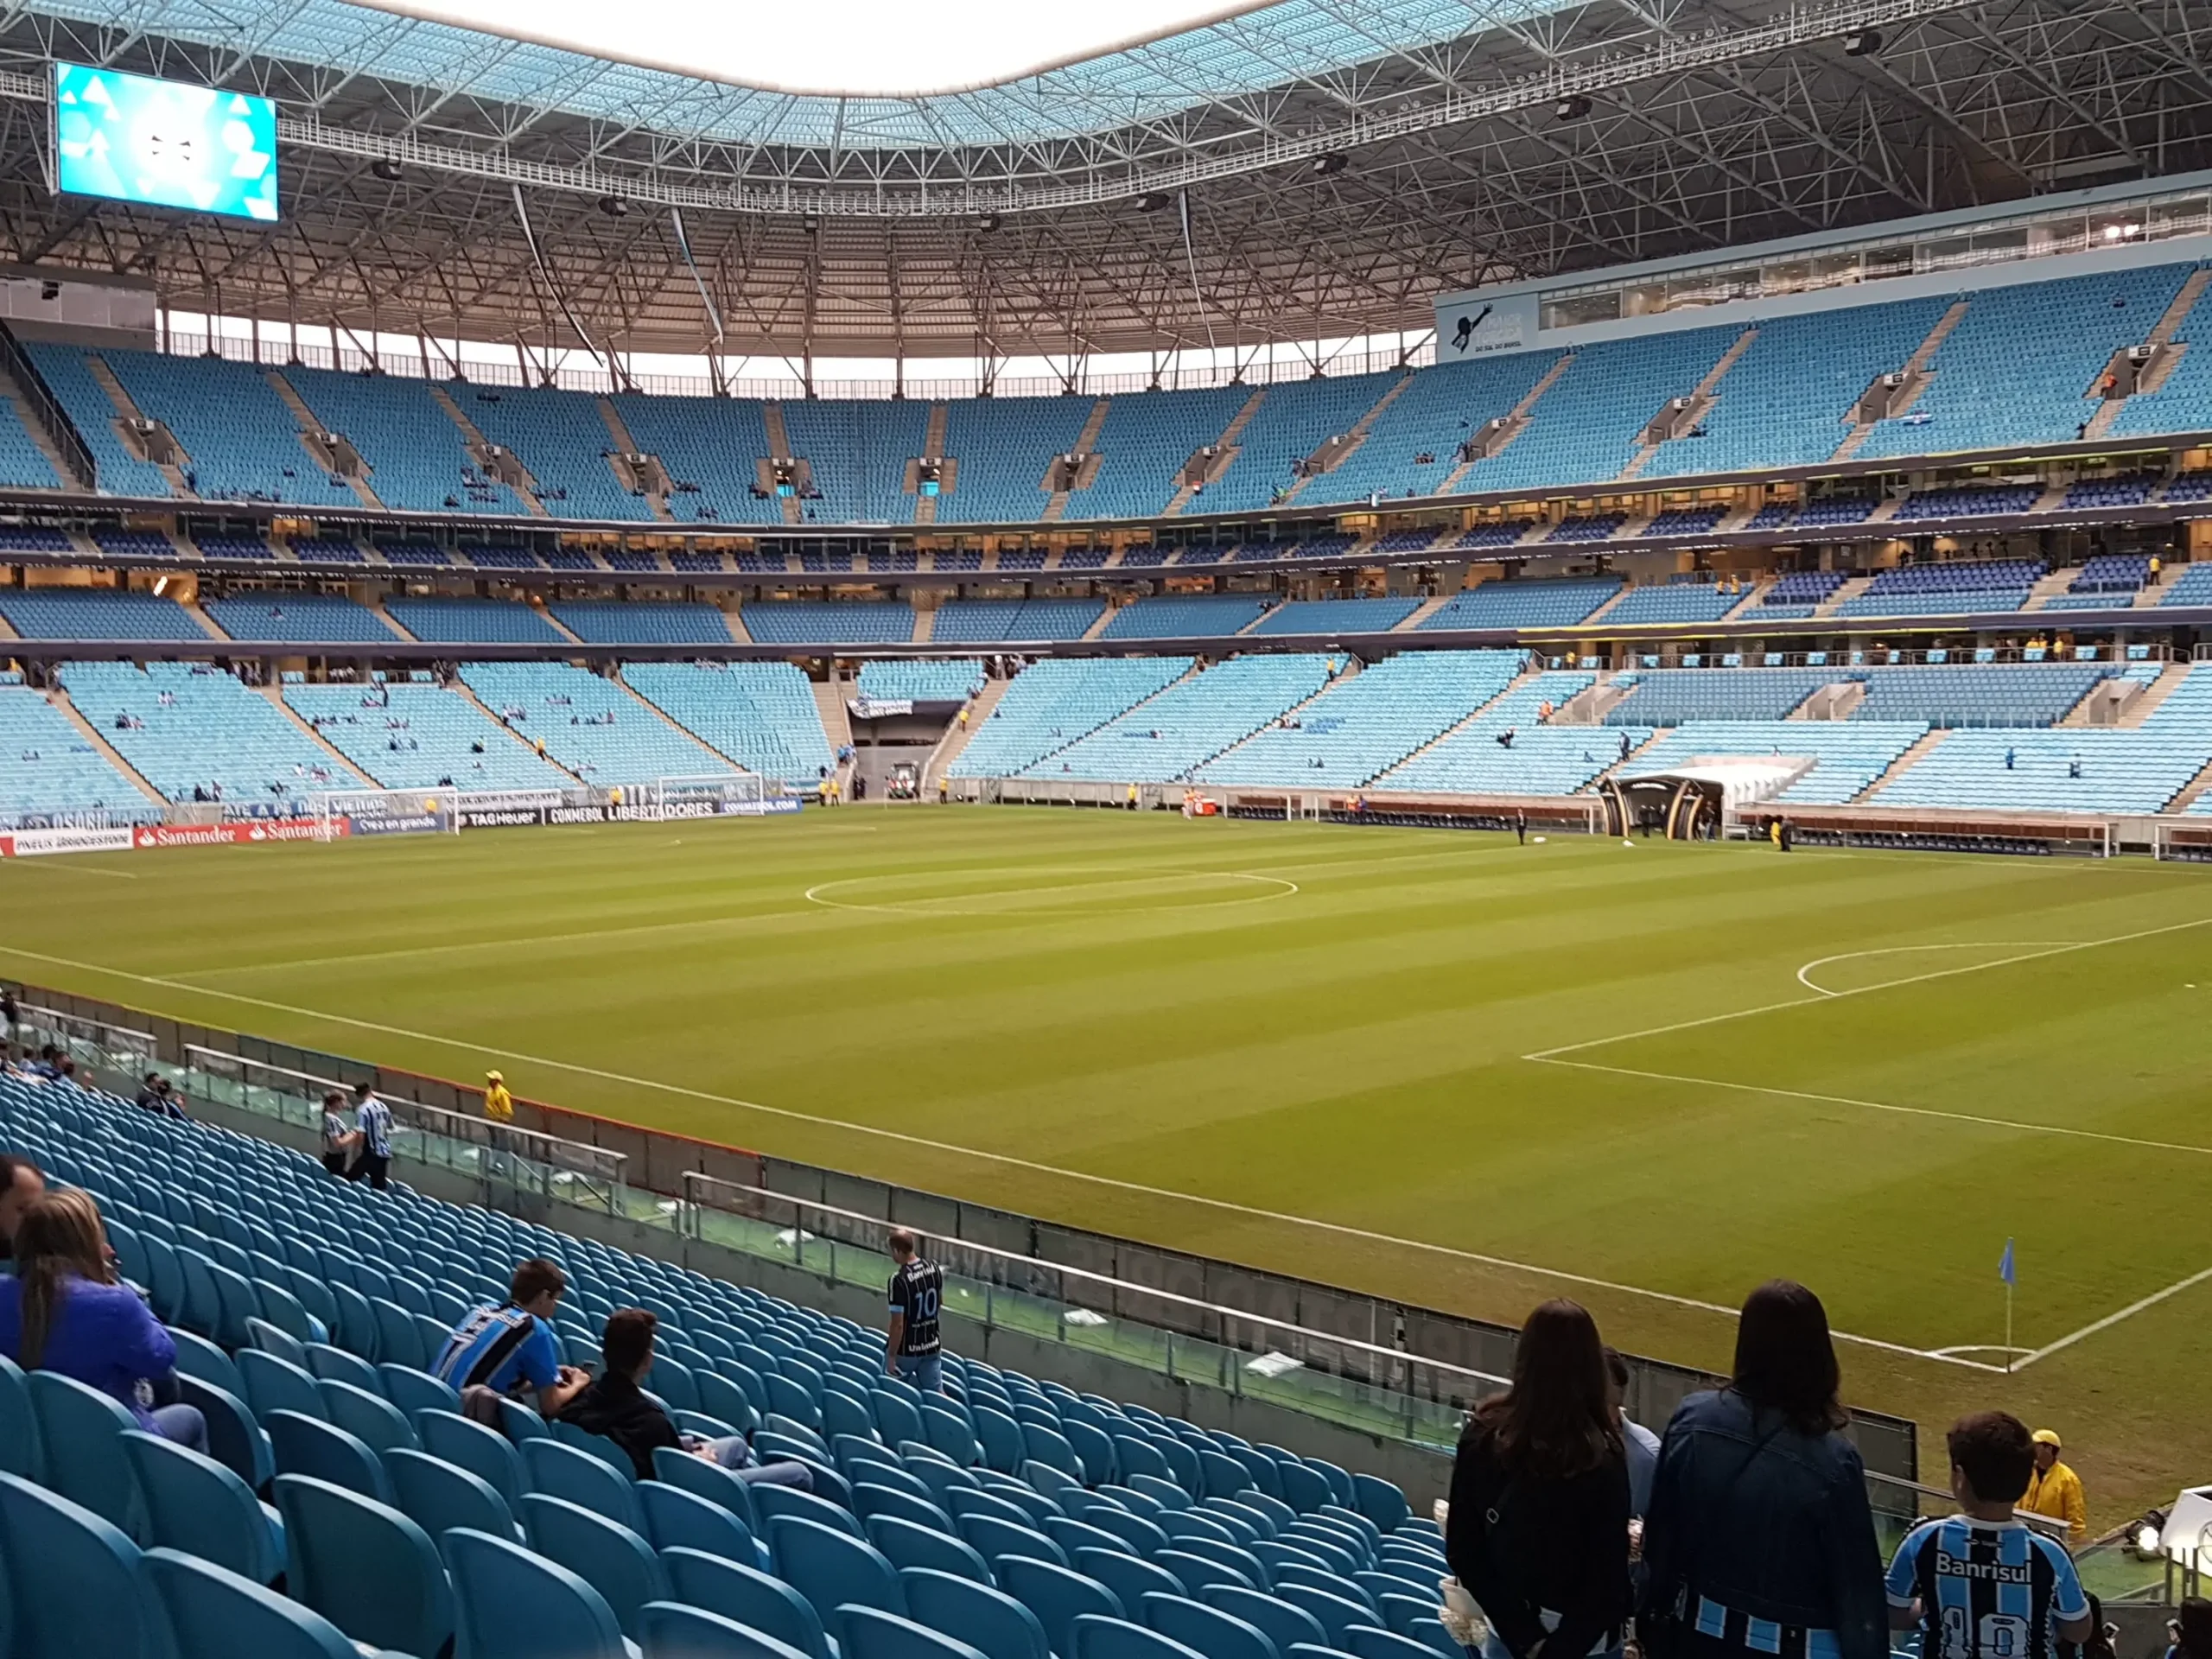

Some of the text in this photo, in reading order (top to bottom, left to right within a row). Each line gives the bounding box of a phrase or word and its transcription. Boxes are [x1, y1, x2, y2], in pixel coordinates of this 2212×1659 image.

[607, 802, 713, 821] LIBERTADORES
[157, 825, 236, 846] Santander
[268, 818, 343, 839] Santander
[915, 1287, 938, 1320] 10
[1936, 1552, 2032, 1584] Banrisul
